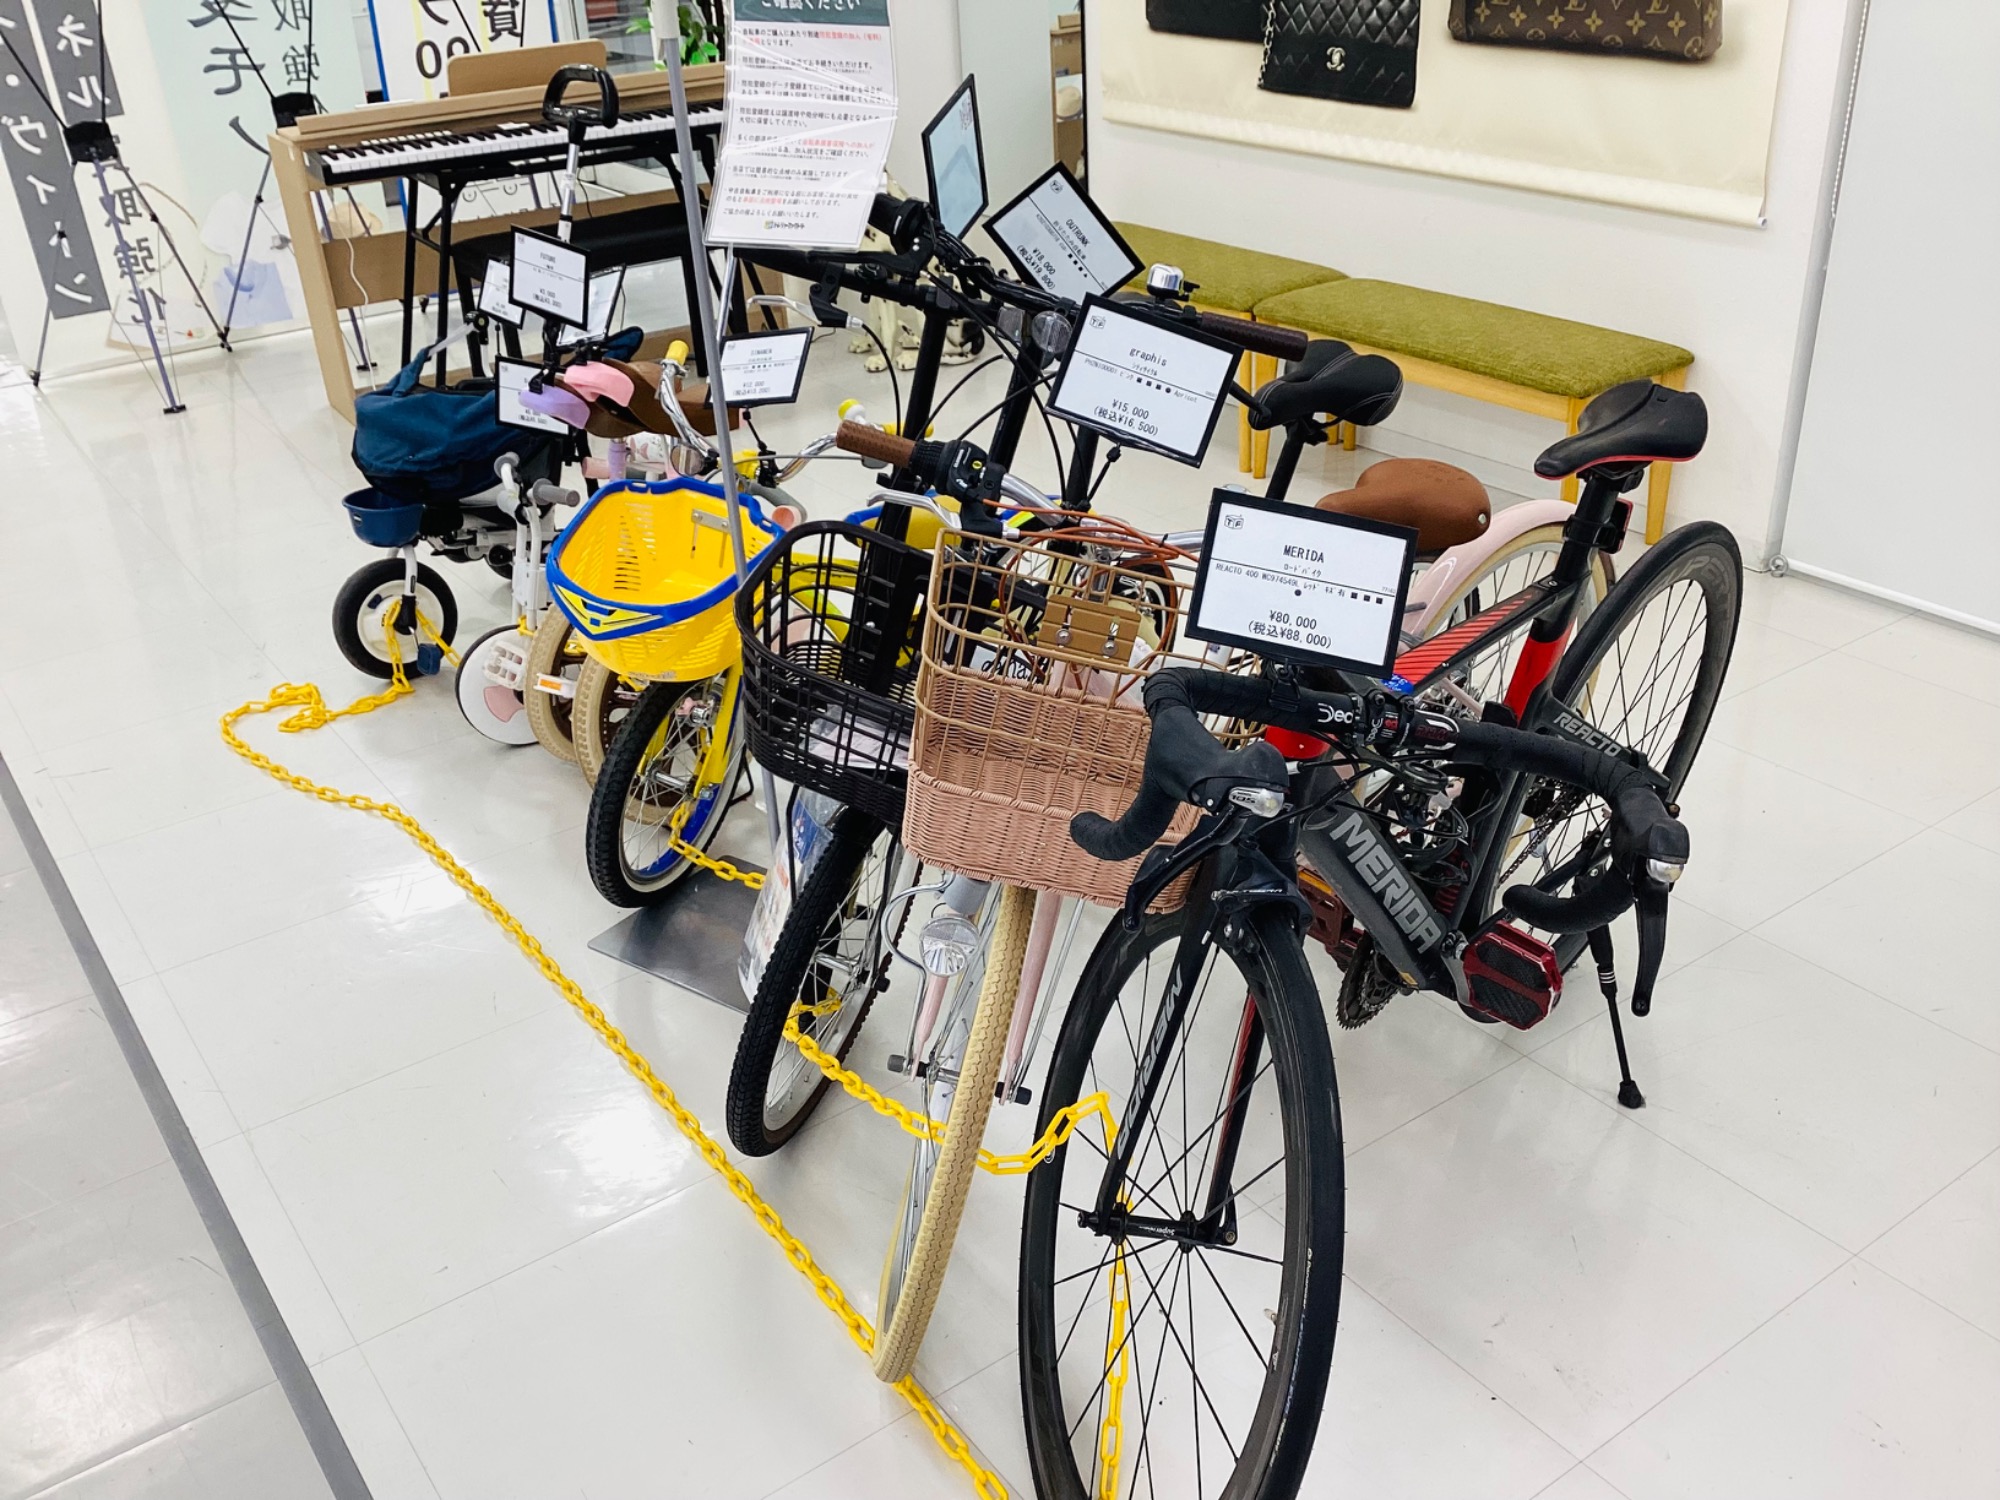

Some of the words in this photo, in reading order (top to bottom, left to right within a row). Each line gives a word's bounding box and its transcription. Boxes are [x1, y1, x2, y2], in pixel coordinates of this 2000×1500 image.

[1129, 347, 1168, 367] graphis
[1112, 398, 1150, 420] ¥15,000
[1283, 544, 1325, 564] MERIDA
[1215, 562, 1242, 576] REACTO
[1245, 568, 1258, 579] 400
[1269, 609, 1317, 630] ¥80,000
[1248, 620, 1332, 649] (税込¥88,000)
[1553, 711, 1622, 757] REACTO
[1329, 812, 1442, 954] MERIDA
